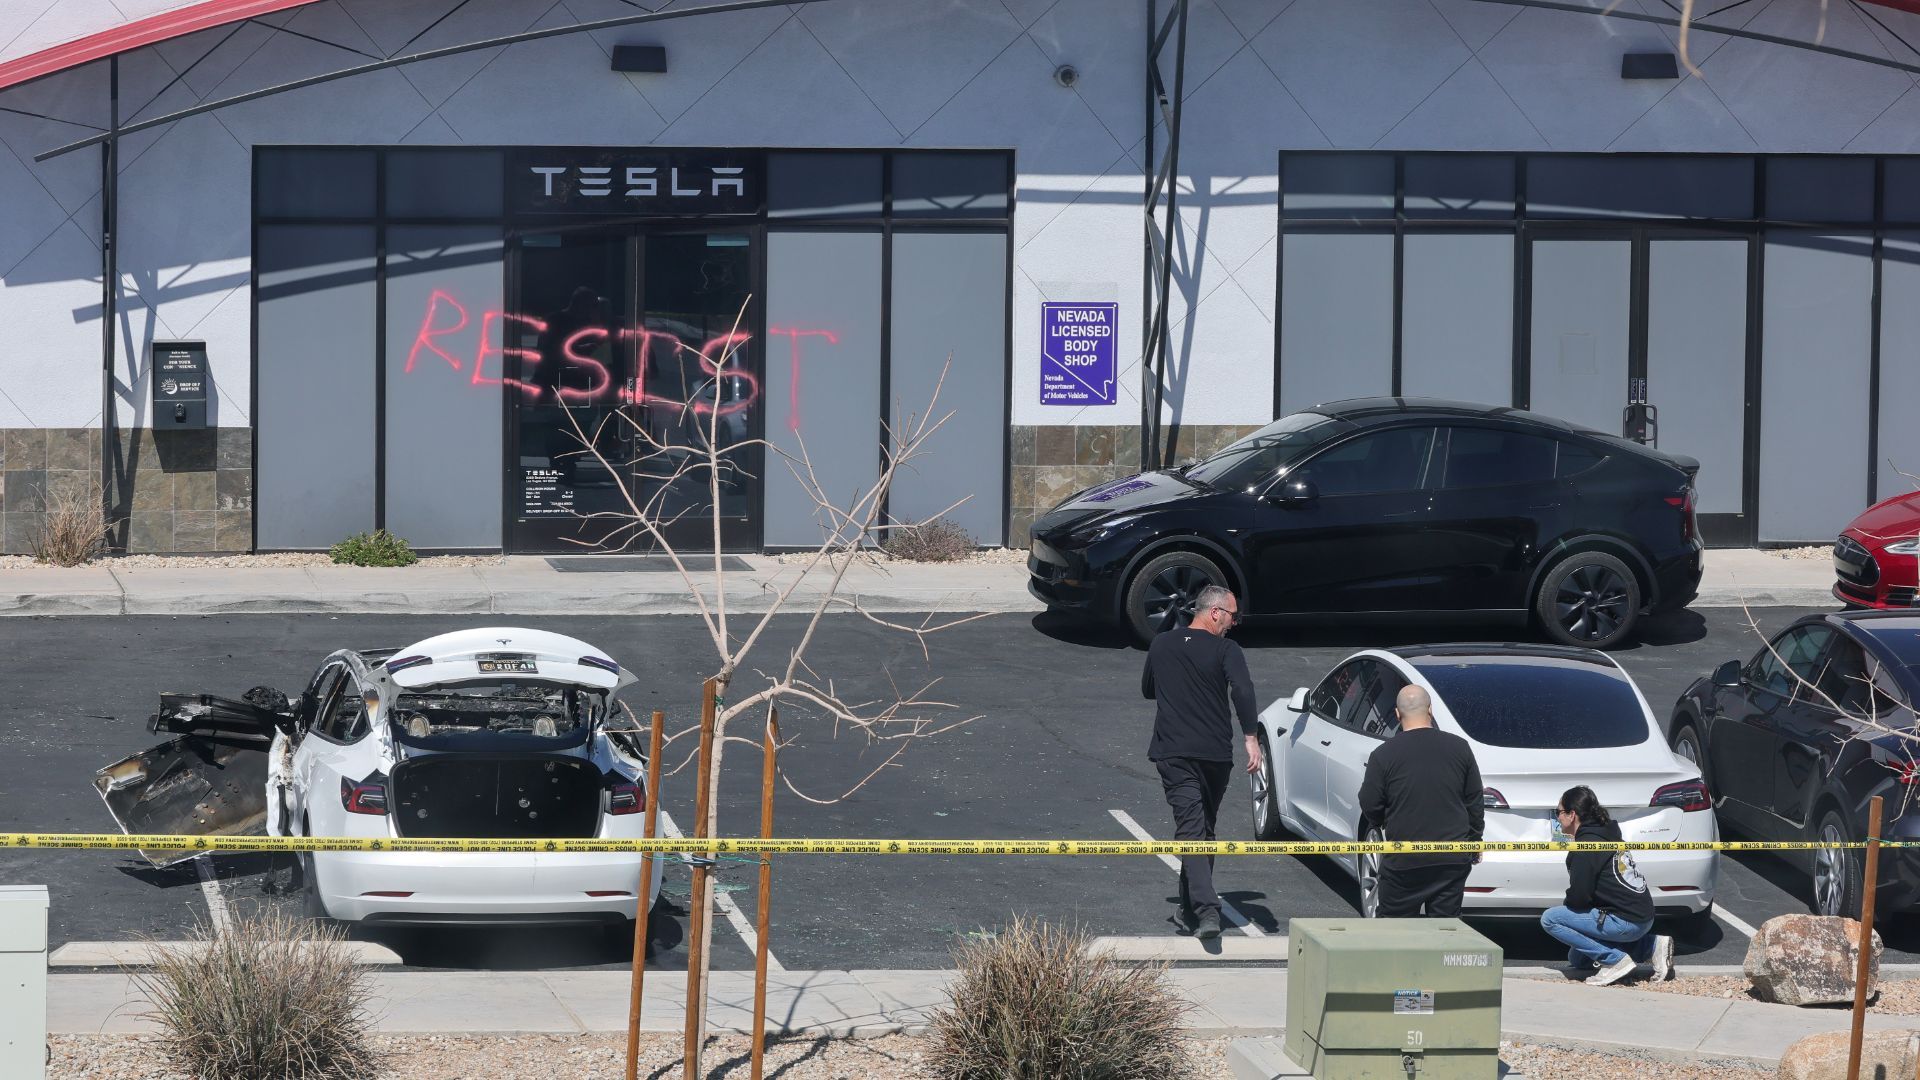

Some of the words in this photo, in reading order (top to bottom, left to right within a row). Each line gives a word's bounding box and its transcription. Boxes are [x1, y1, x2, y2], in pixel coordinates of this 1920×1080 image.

[530, 166, 745, 197] TESLA
[1057, 310, 1106, 322] NEVADA
[1052, 325, 1111, 337] LICENSED
[1064, 340, 1098, 352] BODY
[404, 289, 839, 431] RESIST
[1064, 354, 1098, 366] SHOP
[1044, 384, 1075, 392] Department
[1407, 1030, 1423, 1046] 50
